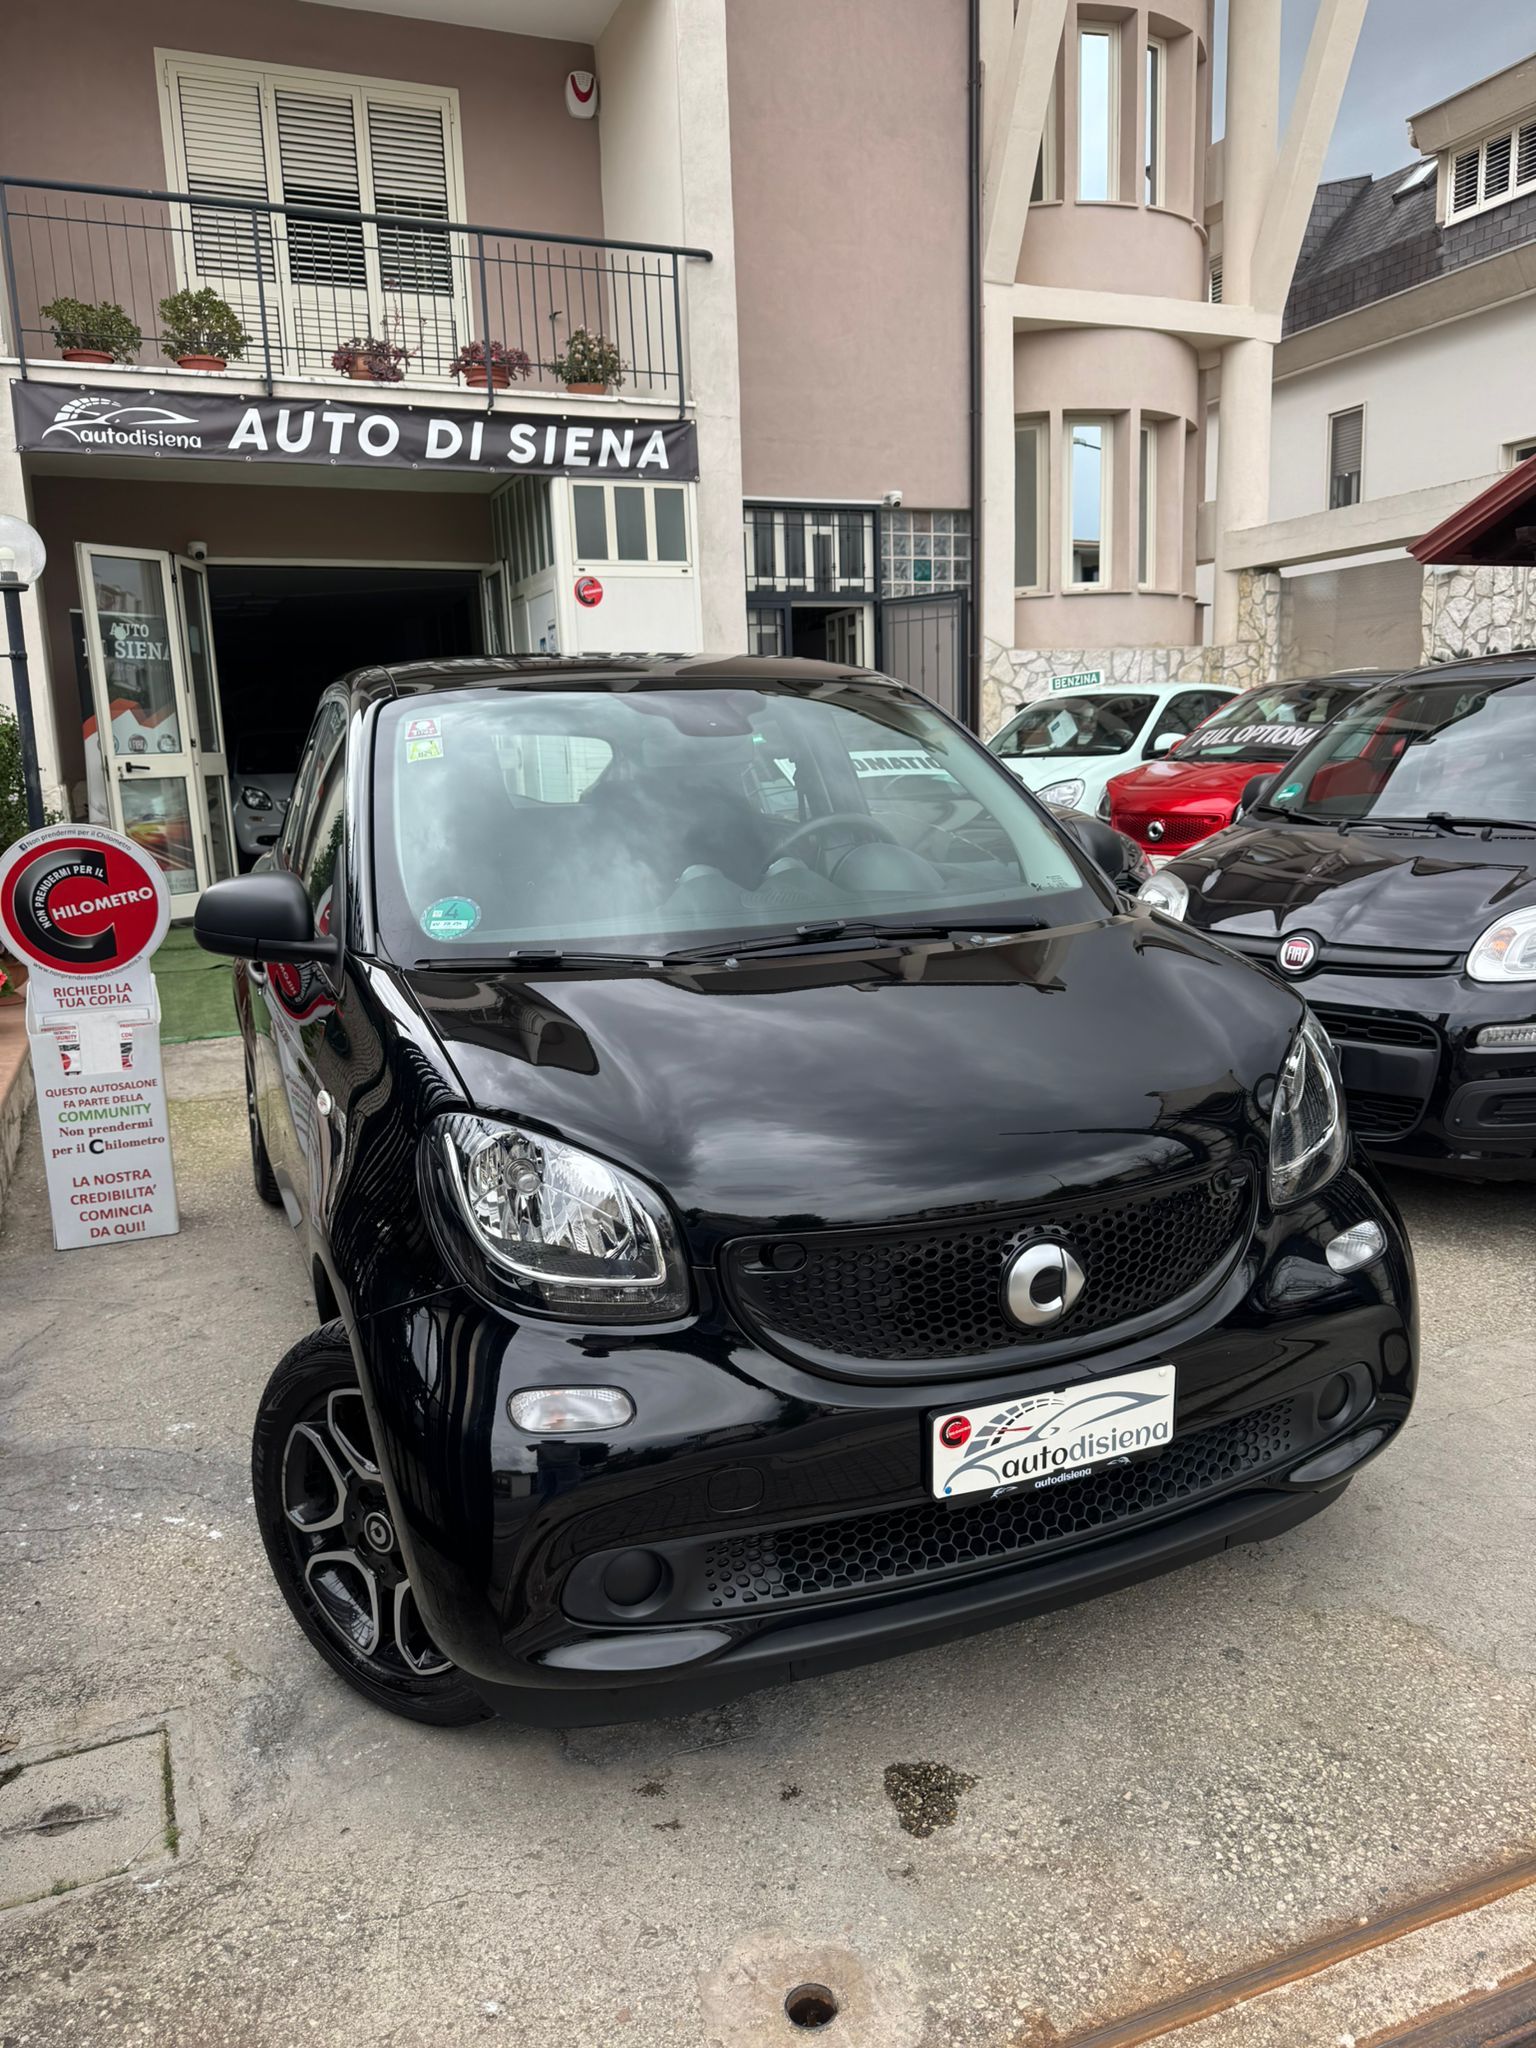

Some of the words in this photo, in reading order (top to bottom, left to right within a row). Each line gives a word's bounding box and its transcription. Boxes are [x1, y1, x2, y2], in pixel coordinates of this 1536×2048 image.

[80, 428, 201, 449] autodisiena
[228, 408, 400, 457] AUTO
[425, 418, 484, 460] DI
[507, 423, 670, 470] SIENA
[1054, 673, 1098, 689] BENZINA
[1191, 726, 1239, 747] FULL
[27, 837, 40, 848] Non
[41, 829, 76, 841] prendermi
[96, 832, 132, 851] Chilometro
[73, 865, 93, 874] PER
[95, 867, 104, 877] IL
[35, 866, 71, 908] PRENDERMI
[35, 909, 52, 929] NON
[445, 902, 459, 919] 4
[1286, 945, 1309, 962] FIAT
[53, 983, 112, 998] RICHIEDI
[116, 982, 132, 993] LA
[57, 998, 86, 1008] TUA
[89, 994, 131, 1006] COPIA
[45, 1086, 87, 1098] QUESTO
[90, 1079, 158, 1094] AUTOSALONE
[63, 1100, 76, 1109] FA
[78, 1096, 110, 1107] PARTE
[112, 1093, 144, 1104] DELLA
[58, 1103, 152, 1123] COMMUNITY
[59, 1126, 84, 1138] Non
[88, 1118, 153, 1137] prendermi
[52, 1147, 73, 1158] per
[77, 1143, 86, 1153] il
[89, 1135, 165, 1155] Chilometro
[72, 1176, 90, 1188] LA
[94, 1168, 152, 1185] NOSTRA
[79, 1203, 153, 1222] COMINCIA
[90, 1226, 111, 1238] DA
[114, 1221, 146, 1236] QUI!
[1001, 1420, 1168, 1479] autodisiena
[1034, 1467, 1092, 1489] autodisiena
